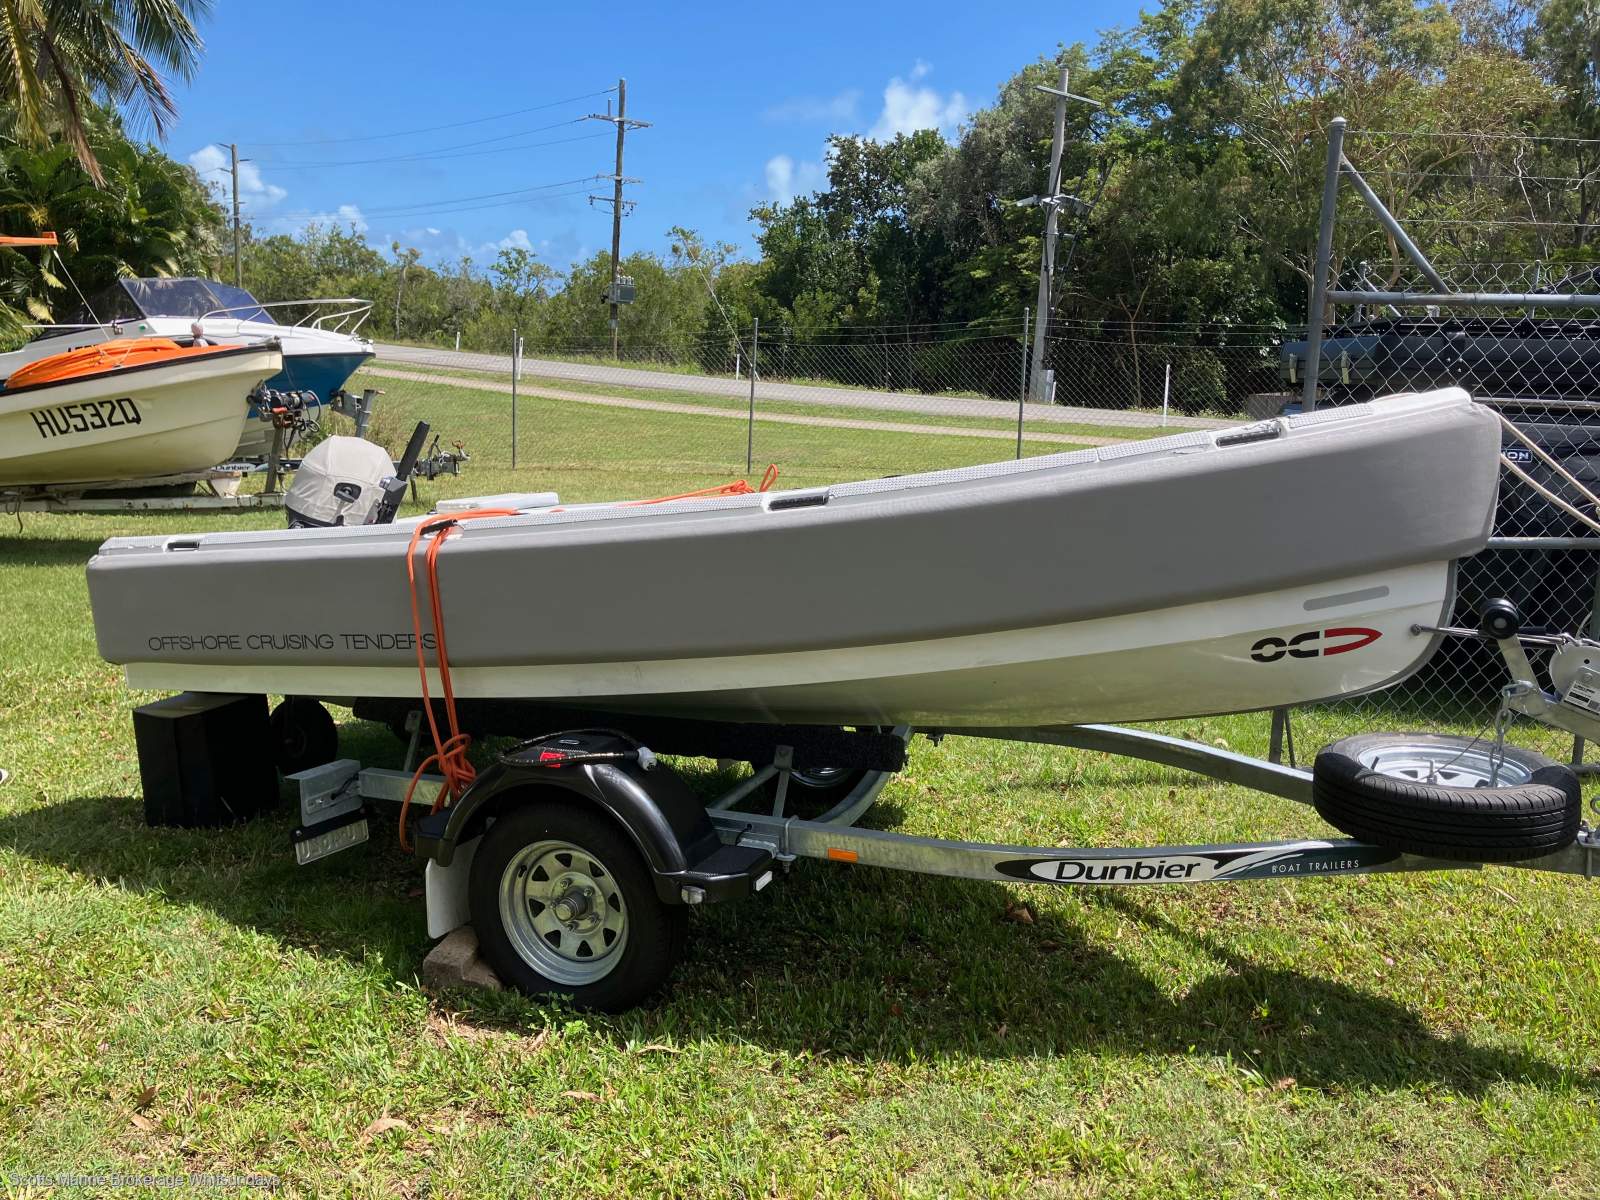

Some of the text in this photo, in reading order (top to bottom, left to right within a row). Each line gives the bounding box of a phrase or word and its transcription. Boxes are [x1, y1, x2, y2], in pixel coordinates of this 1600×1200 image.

[30, 397, 142, 438] HU532Q
[148, 634, 241, 651] OFFSHORE
[246, 633, 335, 650] CRUISING
[1055, 859, 1360, 881] Dunbier BOAT TRAILERS
